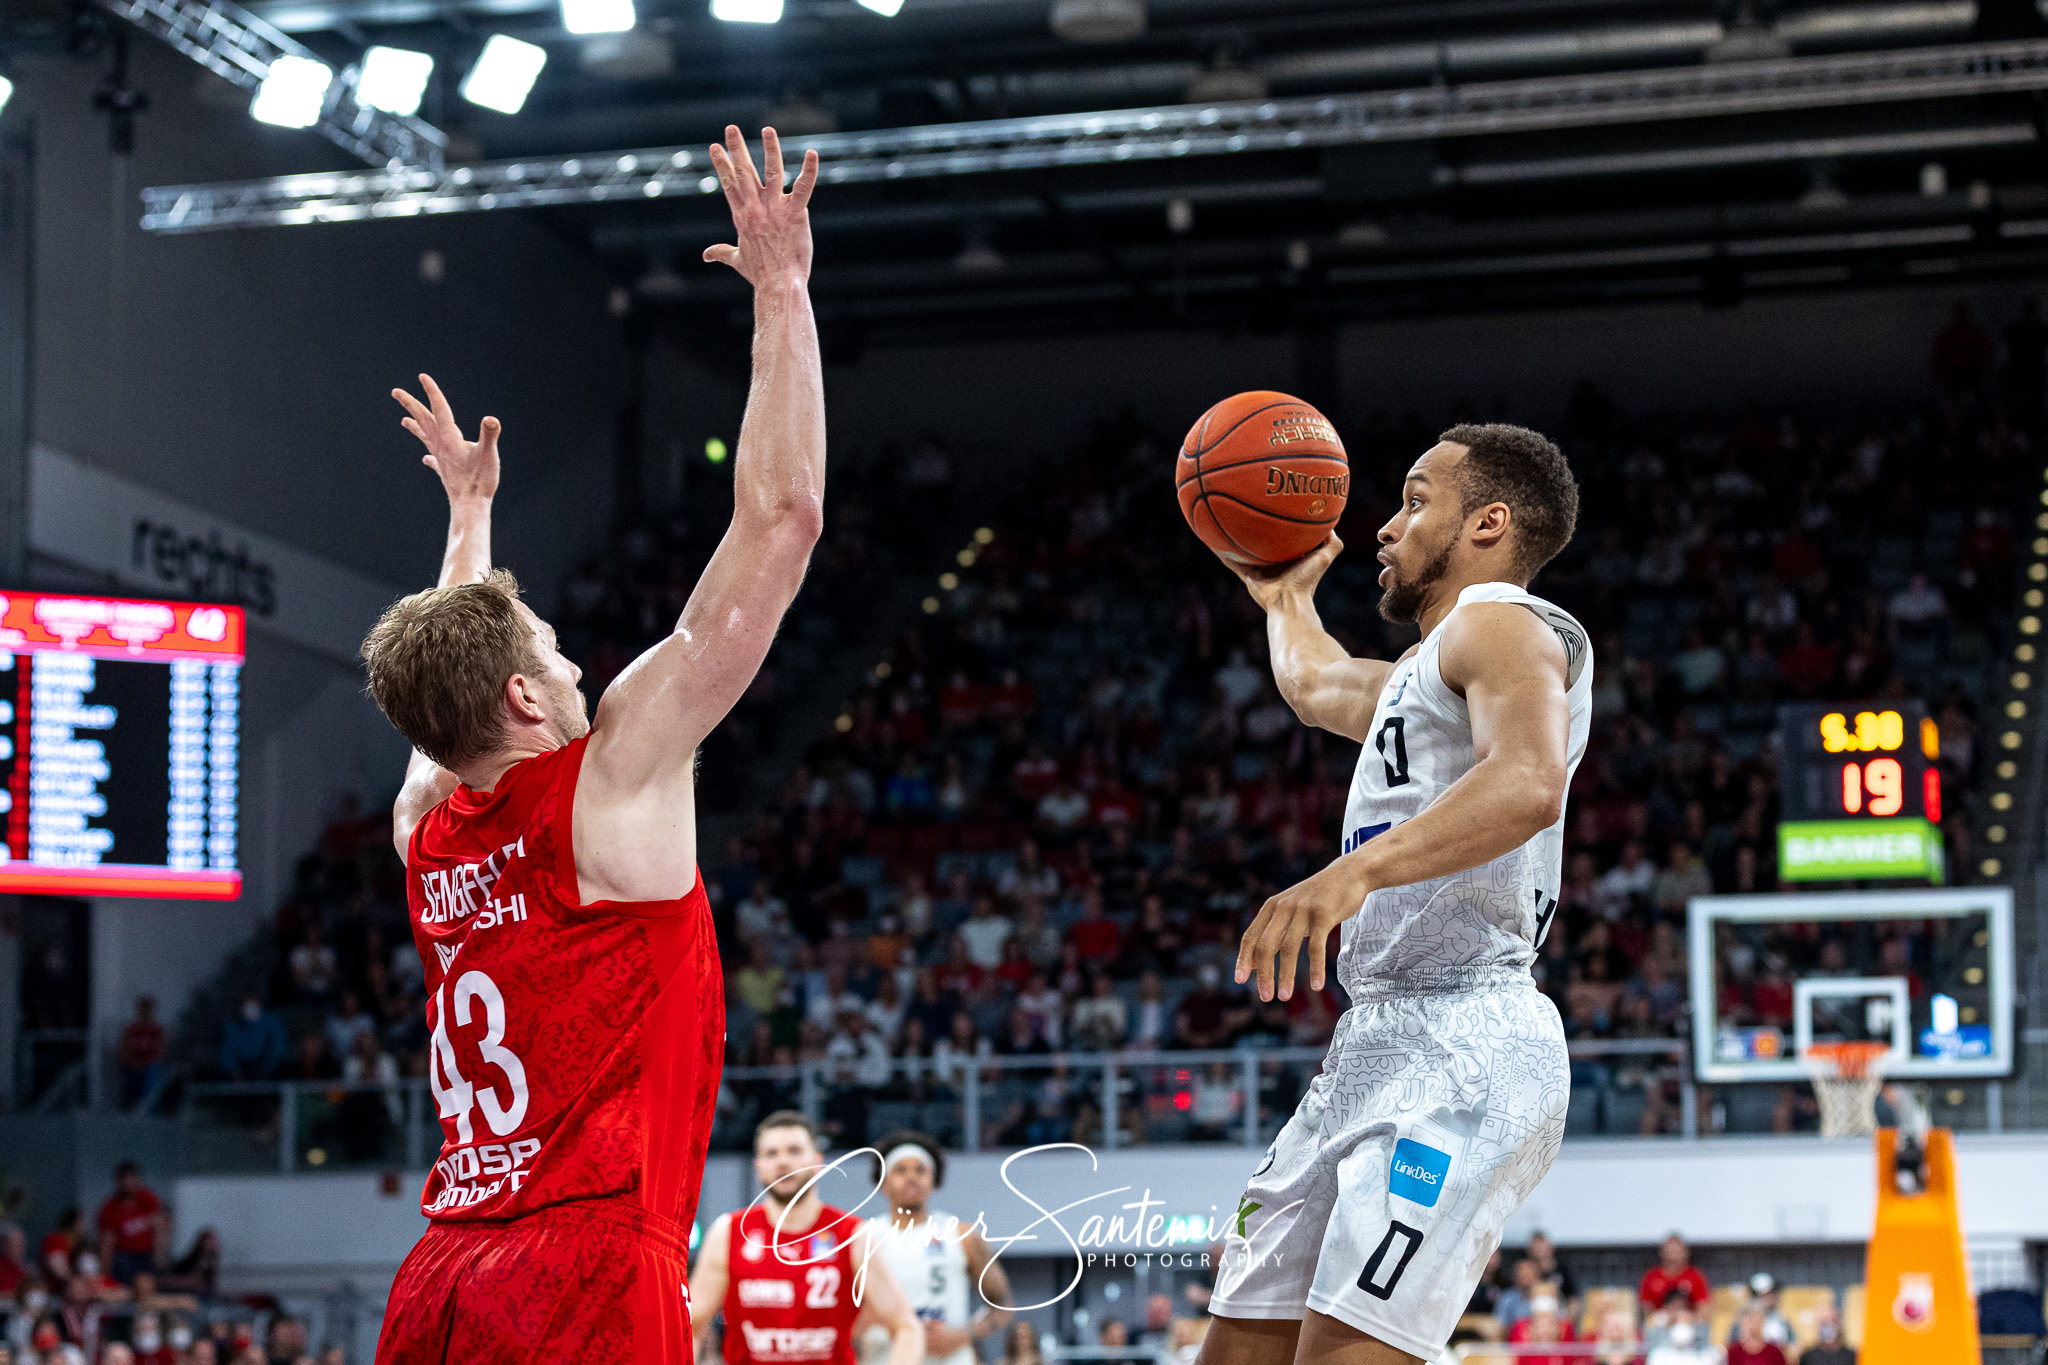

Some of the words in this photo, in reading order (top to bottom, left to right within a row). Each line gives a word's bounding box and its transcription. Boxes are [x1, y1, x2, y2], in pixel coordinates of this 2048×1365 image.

[1375, 716, 1411, 789] 0
[1842, 757, 1903, 817] 19
[429, 970, 530, 1145] 43
[1394, 1160, 1440, 1185] LinkDes
[805, 1266, 842, 1309] 22
[928, 1263, 947, 1295] 5
[1356, 1219, 1425, 1301] 0
